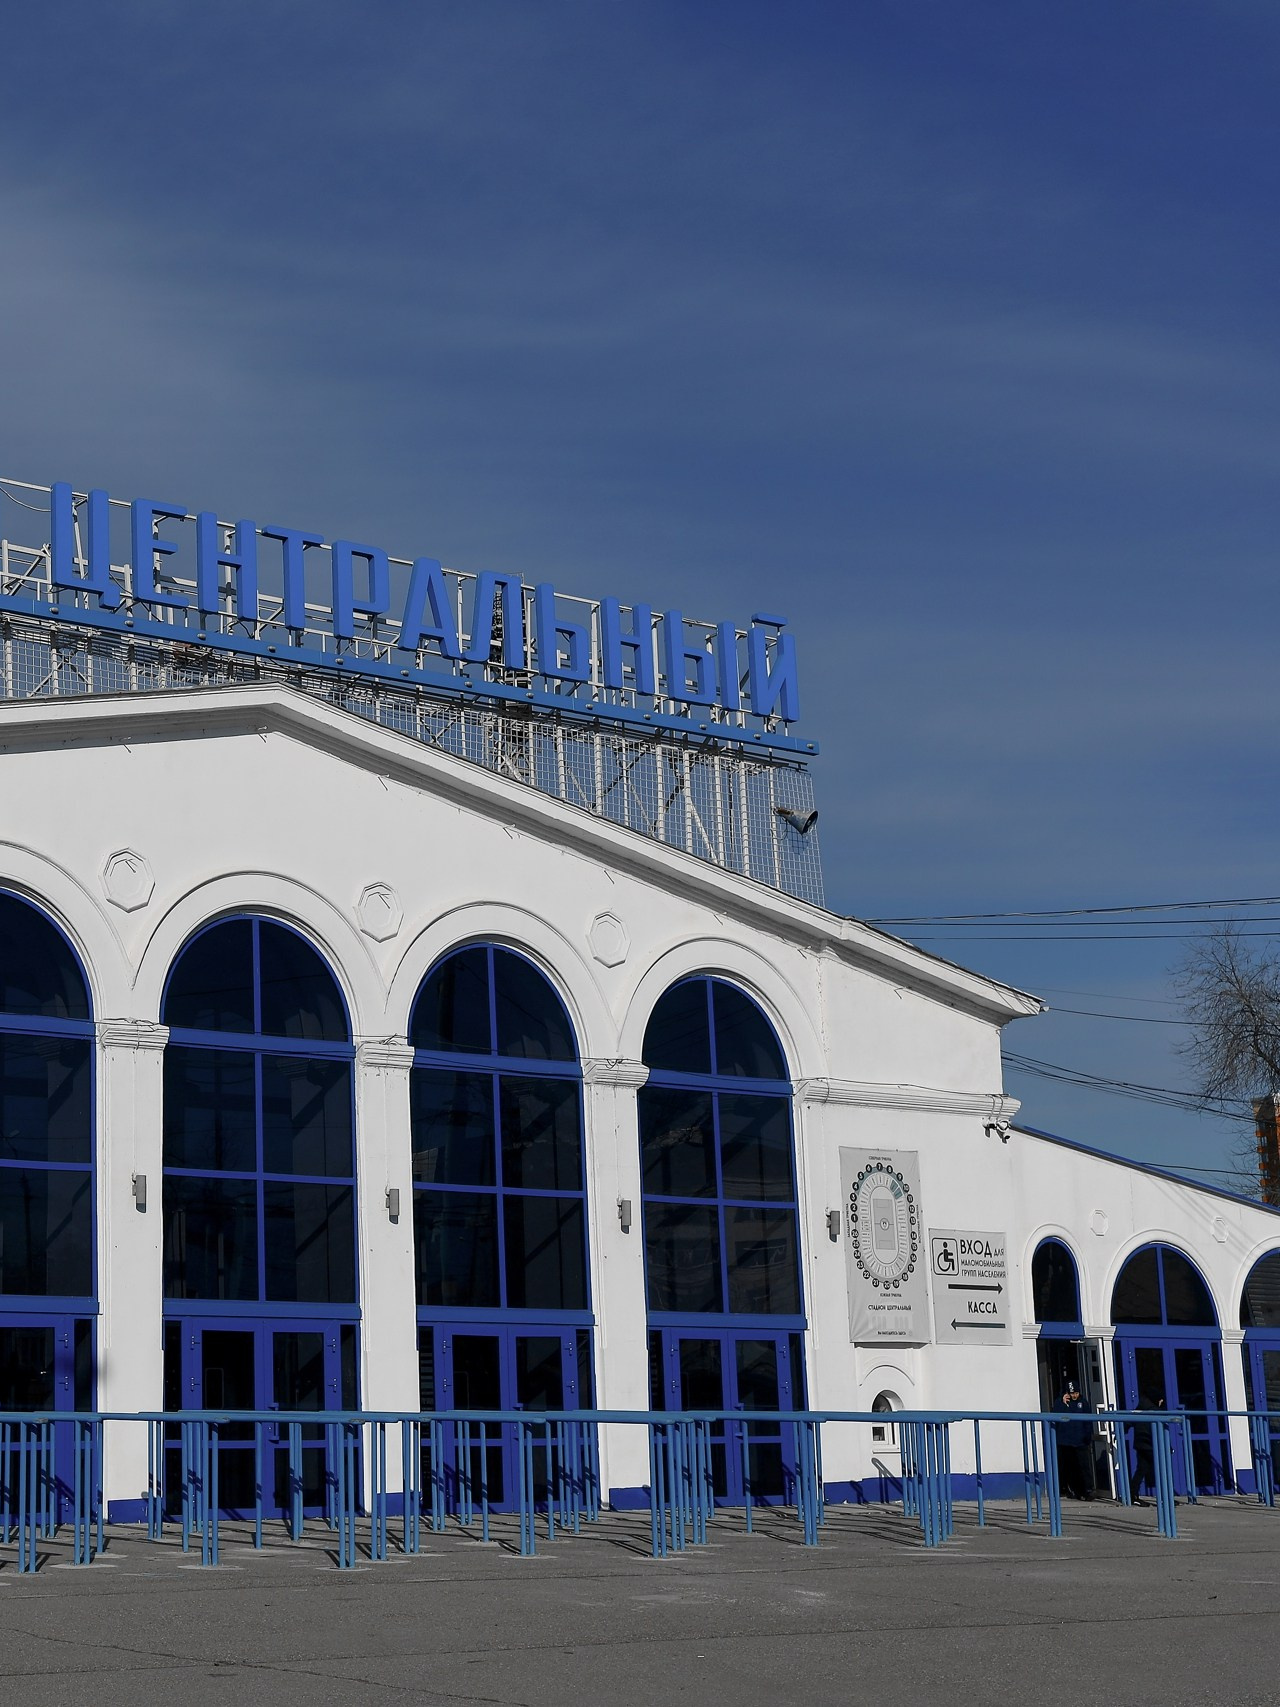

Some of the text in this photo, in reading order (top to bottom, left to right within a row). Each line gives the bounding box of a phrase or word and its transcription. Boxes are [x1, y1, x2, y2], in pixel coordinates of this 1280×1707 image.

[50, 481, 801, 723] ЦЕНТРАЛЬНЫЙ
[960, 1239, 1004, 1258] ВХОД ДЛЯ
[968, 1301, 998, 1314] КАССА
